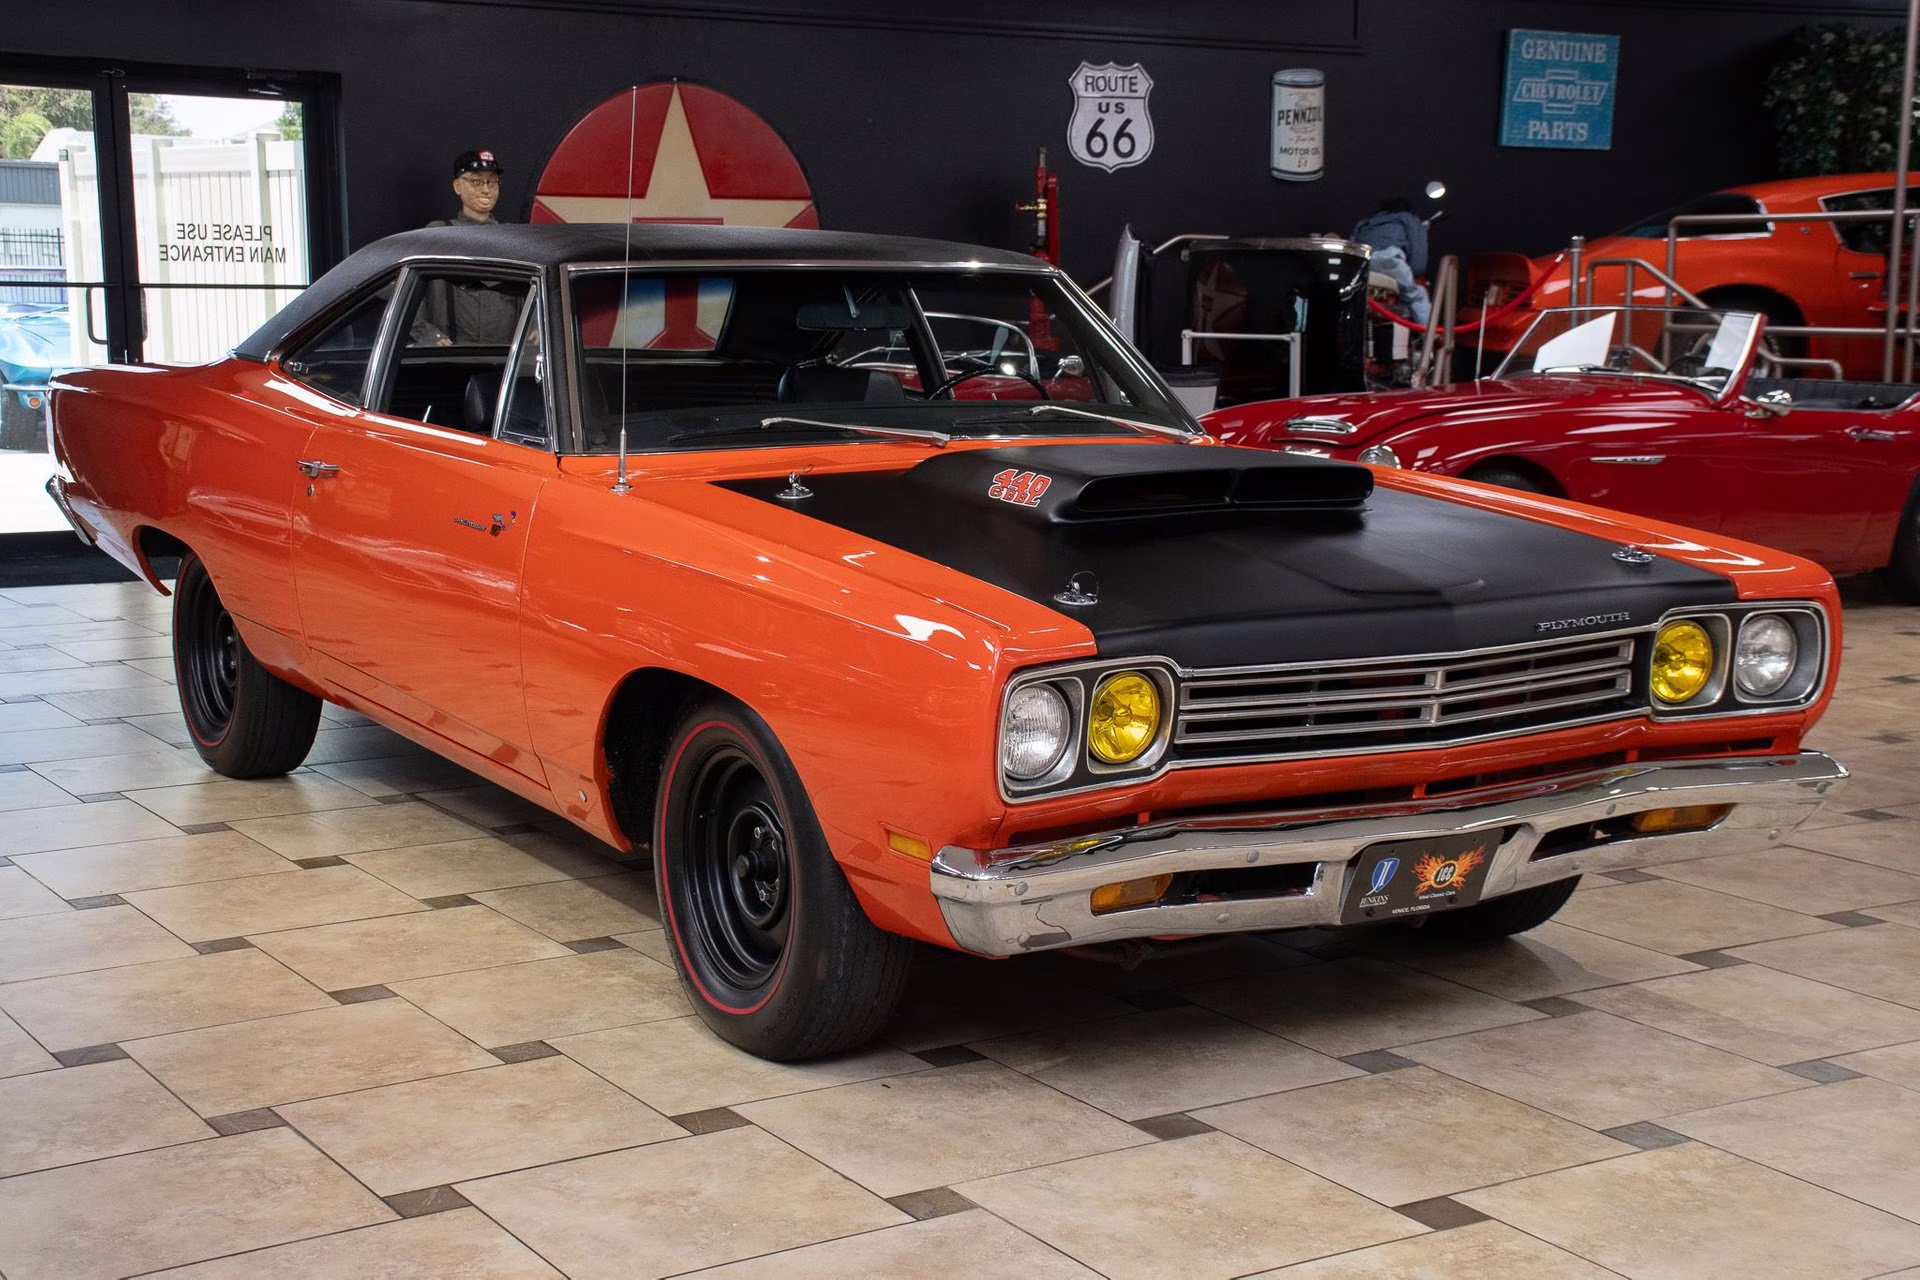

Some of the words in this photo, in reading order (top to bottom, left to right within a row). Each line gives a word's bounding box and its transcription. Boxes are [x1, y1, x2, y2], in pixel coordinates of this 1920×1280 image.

[1521, 39, 1607, 63] GENUINE
[1084, 75, 1138, 93] ROUTE
[1521, 82, 1603, 101] CHEVROLET
[1098, 102, 1125, 114] US
[1085, 117, 1136, 159] 66
[1527, 120, 1589, 142] PARTS
[1280, 146, 1310, 156] MOTOR
[993, 468, 1052, 498] 440
[1536, 612, 1630, 632] PLYMOUTH
[1360, 895, 1389, 905] JENKINS
